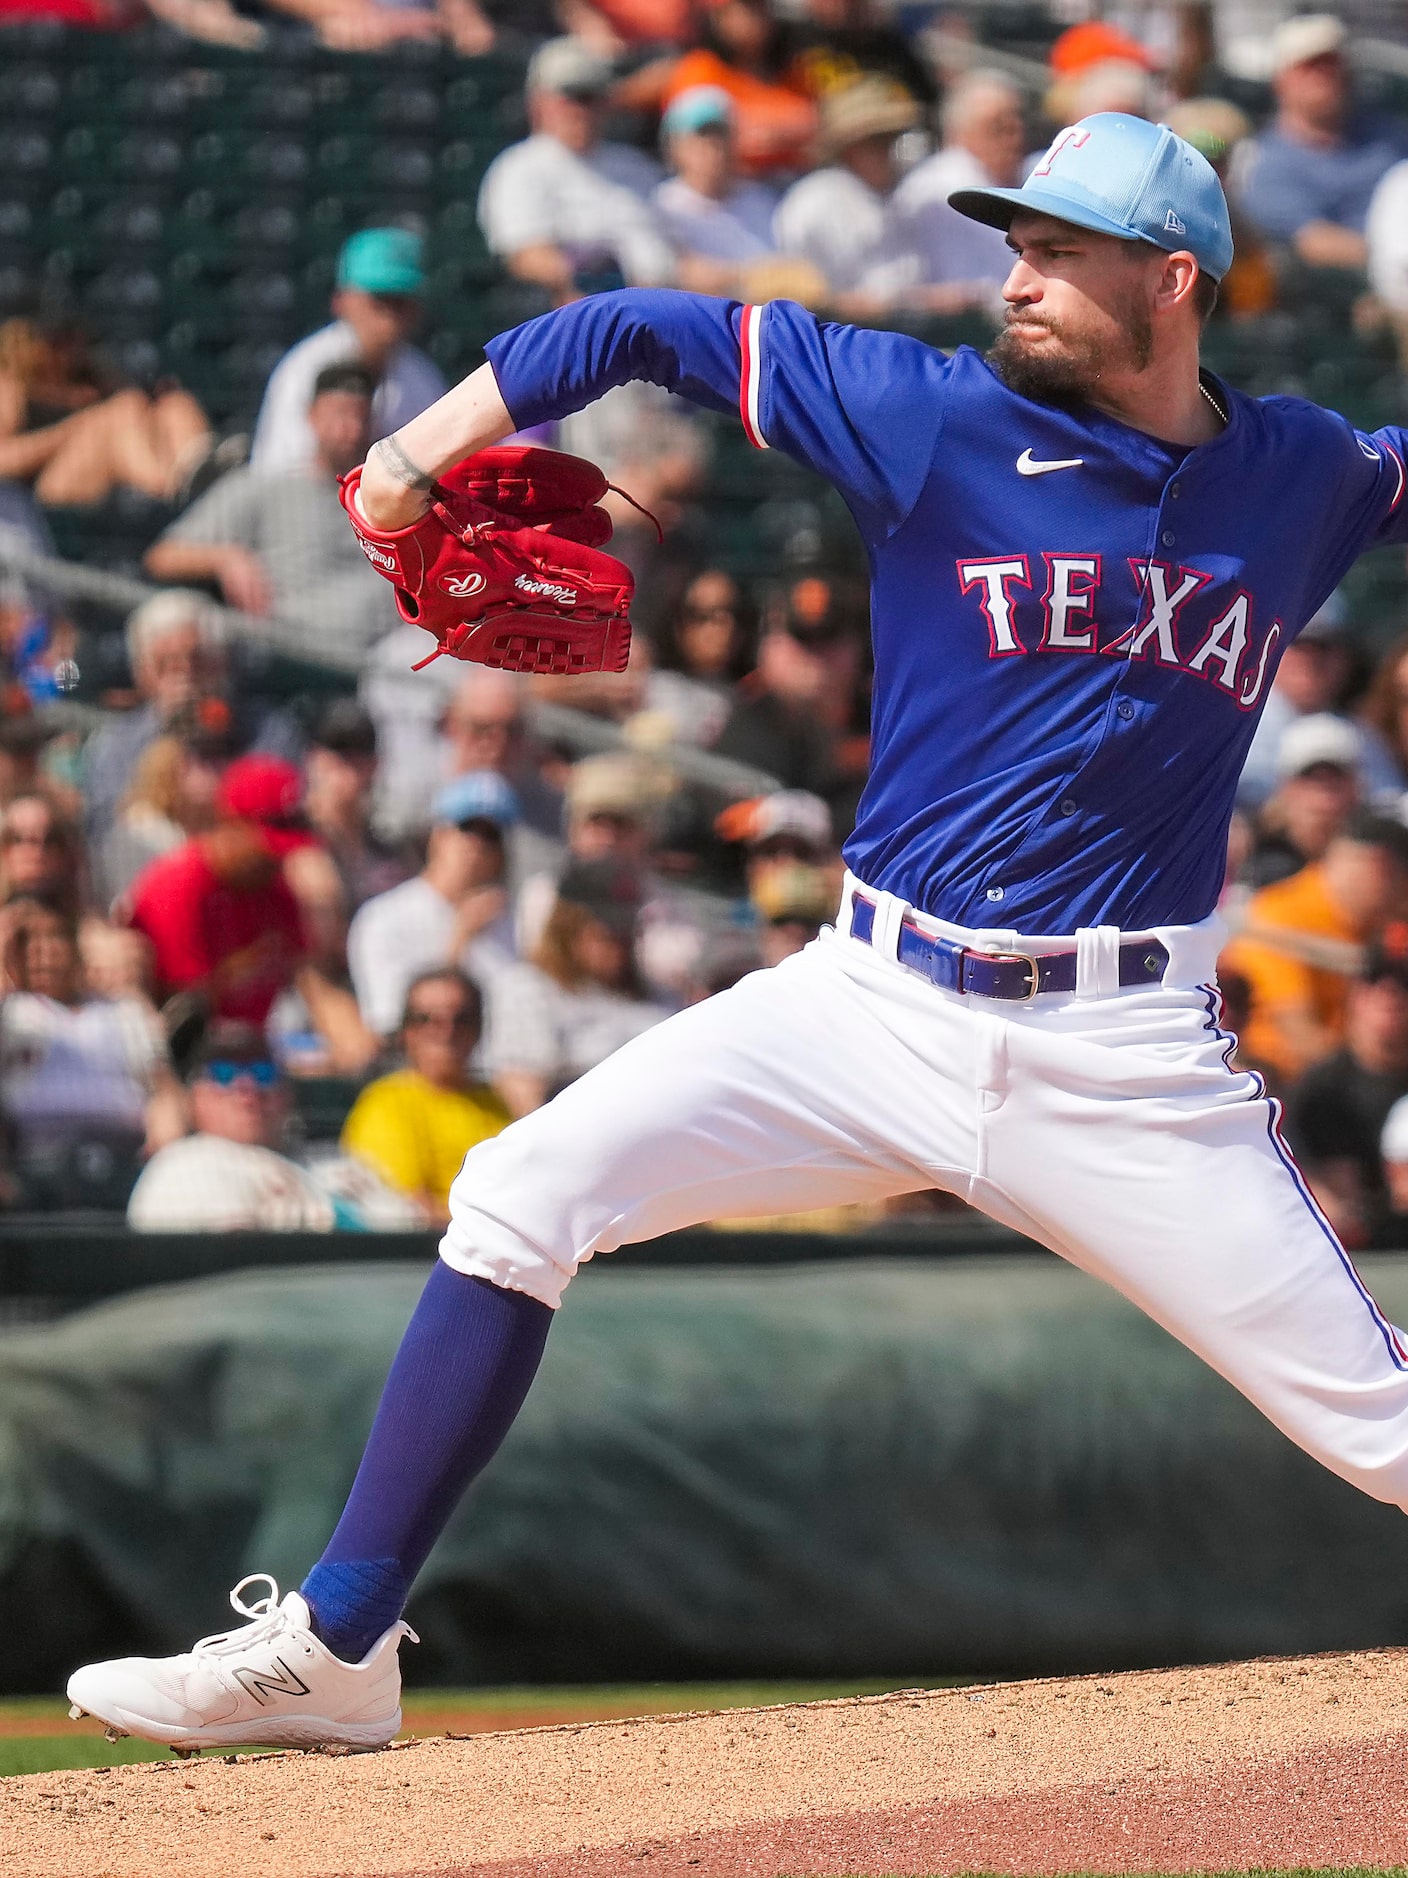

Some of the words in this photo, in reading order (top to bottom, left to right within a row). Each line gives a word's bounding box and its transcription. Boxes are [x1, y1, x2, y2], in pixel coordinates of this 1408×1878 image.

[1034, 126, 1091, 176] T
[514, 573, 577, 605] Heaney
[956, 552, 1283, 712] TEXAS
